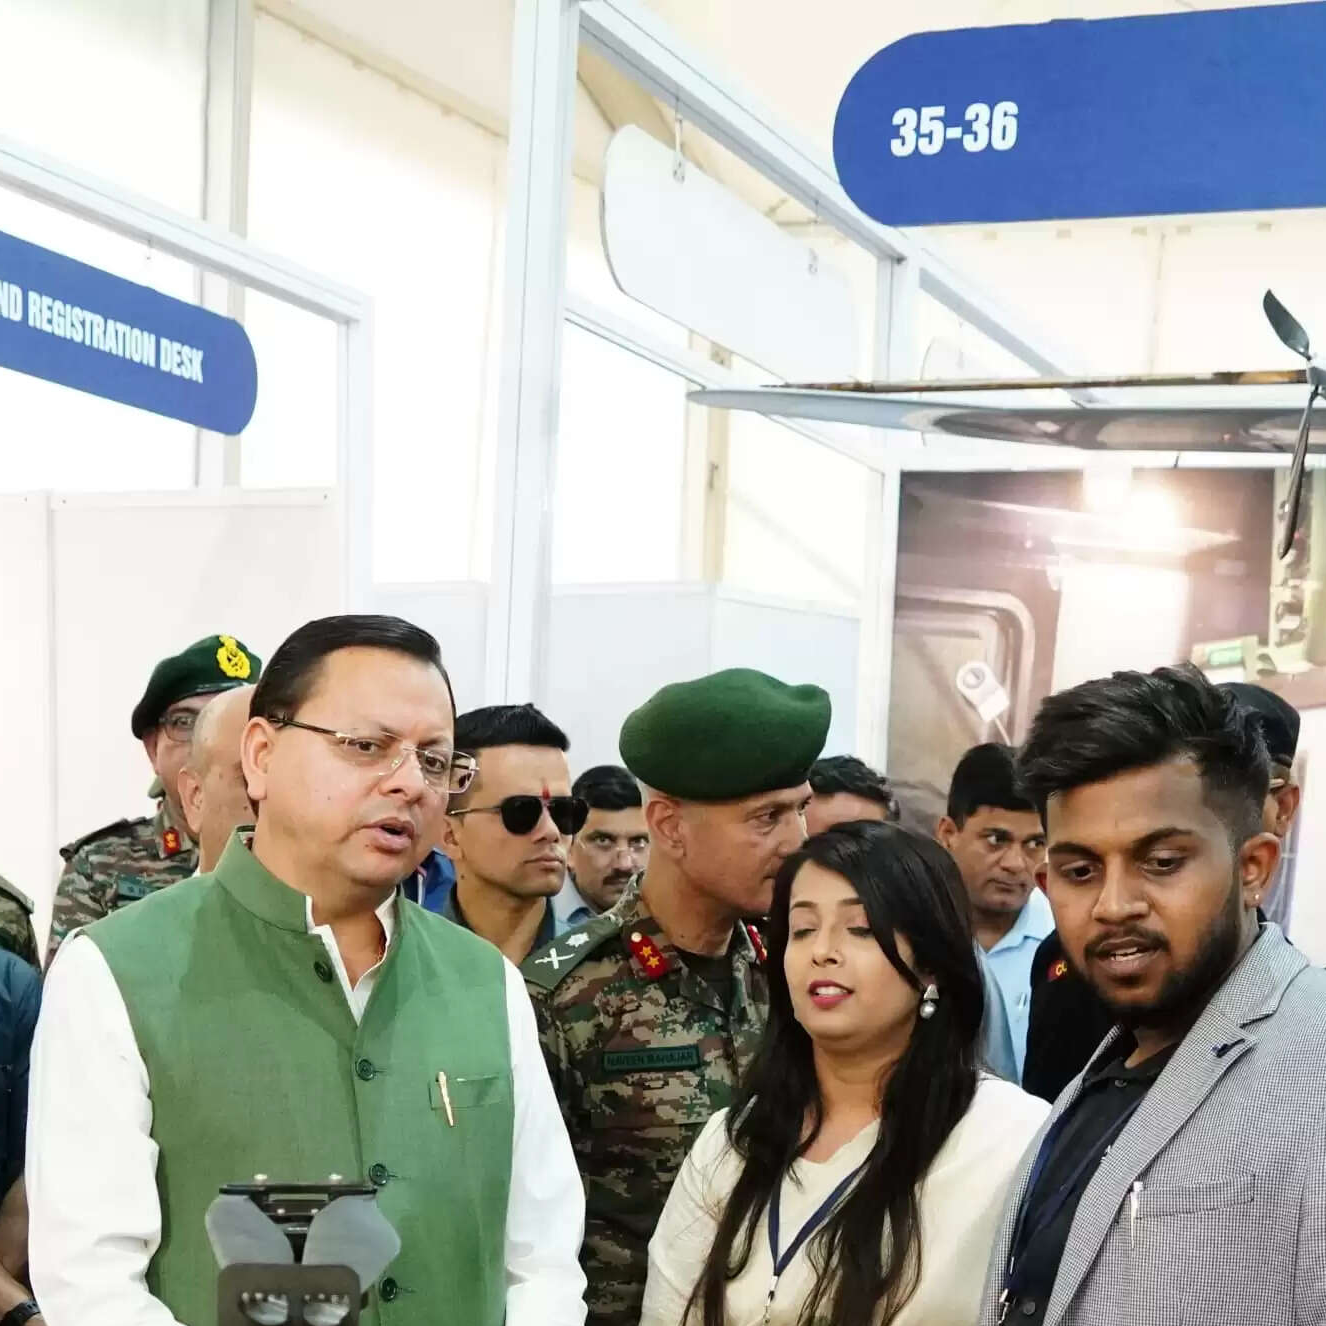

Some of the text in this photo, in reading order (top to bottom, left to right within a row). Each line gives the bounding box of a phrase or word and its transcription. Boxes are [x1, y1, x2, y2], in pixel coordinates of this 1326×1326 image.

[890, 101, 1019, 157] 35-36
[28, 291, 156, 368] REGISTRATION
[159, 336, 204, 384] DESK
